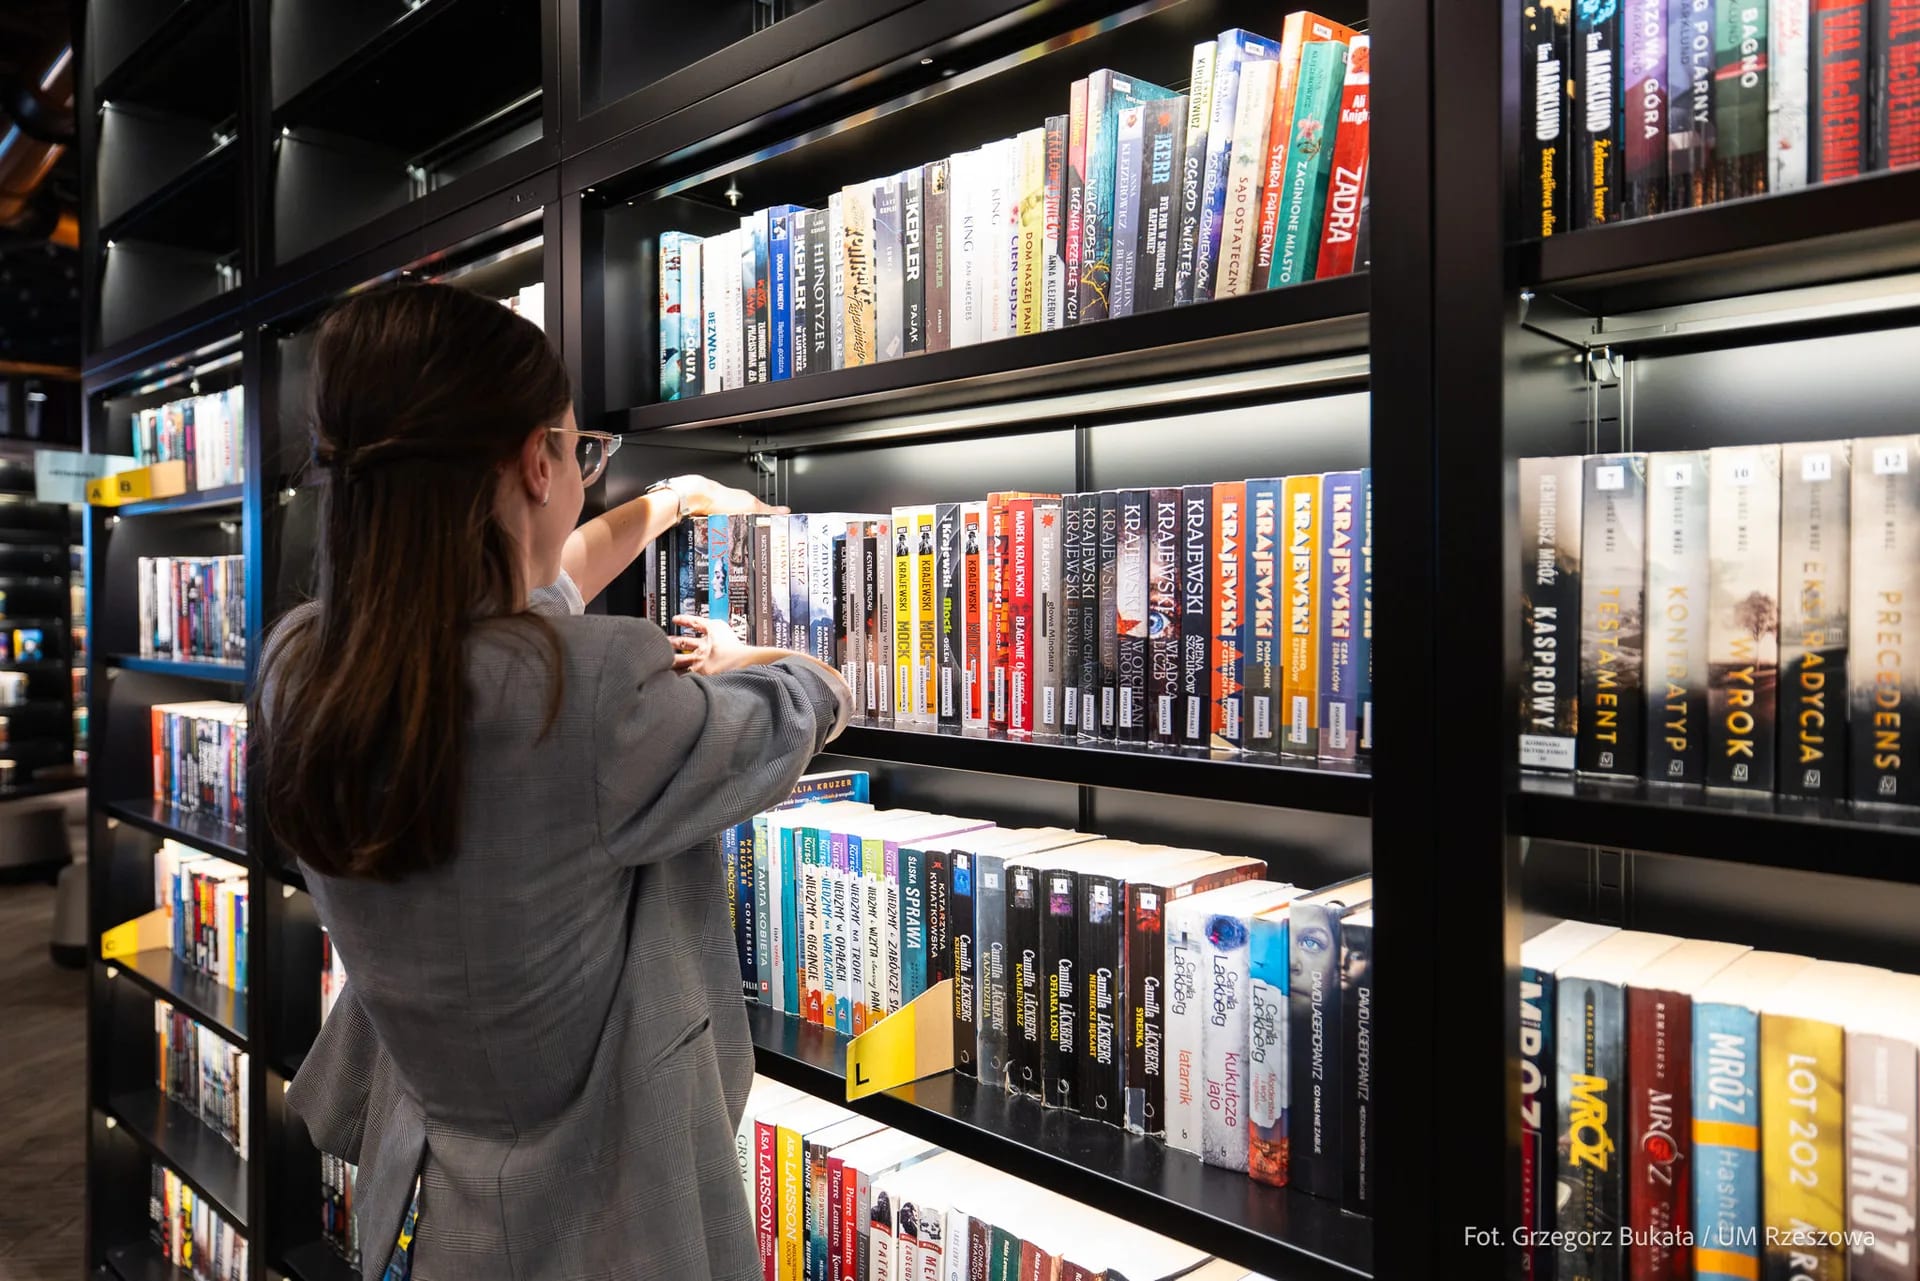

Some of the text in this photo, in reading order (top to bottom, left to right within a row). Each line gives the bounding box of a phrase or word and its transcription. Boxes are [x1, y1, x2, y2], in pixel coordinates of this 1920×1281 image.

[1693, 20, 1709, 123] POLARNY
[1741, 7, 1758, 88] BAGNO
[1352, 95, 1366, 109] Ali
[1536, 60, 1560, 140] MARKLUND
[1586, 49, 1611, 133] MARKLUND
[1644, 78, 1661, 140] GÓRA
[1118, 142, 1131, 234] KLEJZEROWICZ
[1152, 139, 1172, 185] KERR
[963, 216, 976, 252] KING
[1084, 178, 1099, 270] NAGROBEK
[1146, 208, 1158, 255] KAPITANIE?
[1153, 196, 1169, 290] BYŁ PAN W SMOLEŃSKU,
[1181, 158, 1198, 278] OGRÓD ŚWIATEŁ
[1196, 154, 1217, 289] OSIEDLE ODMIEŃCÓW
[1226, 177, 1248, 295] SĄD OSTATECZNY
[1258, 144, 1284, 268] STARA PAPIERNIA
[1279, 161, 1308, 283] ZAGINIONE MIASTO
[1327, 166, 1362, 243] ZADRA
[1542, 209, 1556, 237] ulica
[1593, 186, 1609, 224] krew
[794, 241, 807, 311] KEPLER
[906, 202, 921, 343] KEPLER PAJĄK
[1025, 263, 1033, 304] NASZEJ
[1048, 255, 1056, 276] ANNA
[1067, 187, 1082, 320] KUŹNIA PRZEKLĘTYCH
[1124, 252, 1134, 308] MEDALION
[813, 243, 826, 353] HIPNOTYZER
[1023, 307, 1031, 333] PANI
[685, 328, 697, 384] POKUTA
[708, 311, 718, 370] BEZWŁAD
[92, 487, 101, 499] A
[120, 480, 132, 494] B
[1538, 474, 1556, 546] REMIGIUSZ
[711, 527, 728, 562] ZŁY
[994, 515, 1002, 609] KRAJEWSKI
[1016, 511, 1025, 543] MAREK
[1102, 508, 1116, 601] KRAJEWSKI
[1124, 504, 1141, 613] KRAJEWSKI
[1157, 502, 1175, 611] KRAJEWSKI
[1187, 499, 1204, 615] KRAJEWSKI
[1290, 493, 1311, 634] KRAJEWSKI
[1329, 494, 1352, 639] KRAJEWSKI
[1537, 547, 1559, 586] MRÓZ
[821, 542, 831, 605] zmowie
[942, 523, 952, 634] Krajewski Mock
[968, 560, 977, 613] KRAJEWSKI
[1015, 545, 1025, 598] KRAJEWSKI
[1064, 510, 1080, 656] KRAJEWSKI ERYNIE
[1080, 507, 1096, 642] KRAJEWSKI LICZBY
[1218, 503, 1239, 636] KRAJEWSKI
[1252, 500, 1273, 638] KRAJEWSKI
[897, 561, 911, 660] KRAJEWSKI MOCK
[920, 560, 935, 660] KRAJEWSKI MOCK
[1015, 616, 1025, 660] BŁAGANIE
[1132, 640, 1144, 728] W OTCHŁANI
[1153, 641, 1165, 679] LICZB
[1165, 640, 1178, 699] WŁADCA
[1185, 634, 1196, 694] SZCZURÓW
[1195, 635, 1204, 671] ARENA
[1262, 641, 1271, 688] POMOCNIK
[1331, 642, 1341, 692] ZDRAJCÓW
[1341, 642, 1349, 665] CZAS
[1533, 606, 1557, 729] KASPROWY
[1596, 586, 1621, 744] TESTAMENT
[1665, 586, 1689, 752] KONTRATYP
[1799, 561, 1826, 765] EKSTRADYCJA
[1873, 591, 1902, 770] PRECEDENS
[1726, 635, 1756, 758] WYROK
[817, 779, 852, 791] KRUZER
[758, 864, 767, 967] TAMTA KOBIETA
[906, 855, 921, 949] ŚLISKA SPRAWA
[929, 872, 938, 958] KWIATKOWSKA
[937, 883, 946, 950] KATARZYNA
[806, 934, 819, 981] GIGANCIE
[823, 934, 834, 991] WAKACJACH
[835, 936, 846, 981] OPAŁACH
[852, 947, 861, 984] TROPIE
[869, 927, 880, 1012] WIZYTA PANI
[888, 940, 899, 993] ZABÓJCZE
[960, 934, 974, 1022] Camilla LÄCKBERG
[983, 951, 992, 1018] KAZNODZIEJA
[992, 942, 1005, 1031] Camilla LÄCKBERG
[1016, 963, 1024, 1026] KAMIENIARZ
[1024, 949, 1038, 1041] Camilla LÄCKBERG
[1312, 971, 1323, 1002] DAVID
[1050, 974, 1059, 1041] OFIARA LOSU
[1058, 958, 1075, 1052] Camilla LÄCKBERG
[1087, 973, 1097, 1057] NIEMIECKI BĘKART
[1097, 967, 1113, 1064] Camilla LÄCKBERG
[1136, 1007, 1144, 1048] SYRENKA
[1144, 976, 1161, 1075] Camilla LÄCKBERG
[1311, 1003, 1323, 1080] LAGERCRANTZ
[1357, 987, 1369, 1019] DAVID
[856, 1063, 870, 1086] L
[1178, 1049, 1192, 1106] latarnik
[1207, 1079, 1223, 1110] jajo
[1224, 1052, 1241, 1127] kukułcze
[1314, 1085, 1321, 1096] CO
[1357, 1020, 1369, 1101] LAGERCRANTZ
[1708, 1032, 1754, 1115] MRÓZ
[1314, 1127, 1322, 1154] ZABIJE
[1569, 1073, 1615, 1172] MRÓZ
[1641, 1088, 1684, 1187] MRÓZ
[1787, 1053, 1818, 1188] LOT 202
[760, 1152, 772, 1233] LARSSON
[785, 1161, 797, 1240] LARSSON
[833, 1169, 841, 1247] Pierre Lemaitre
[1851, 1104, 1916, 1266] MRÓZ
[846, 1186, 855, 1265] Pierre Lemaitre
[976, 1243, 985, 1279] KONRAD
